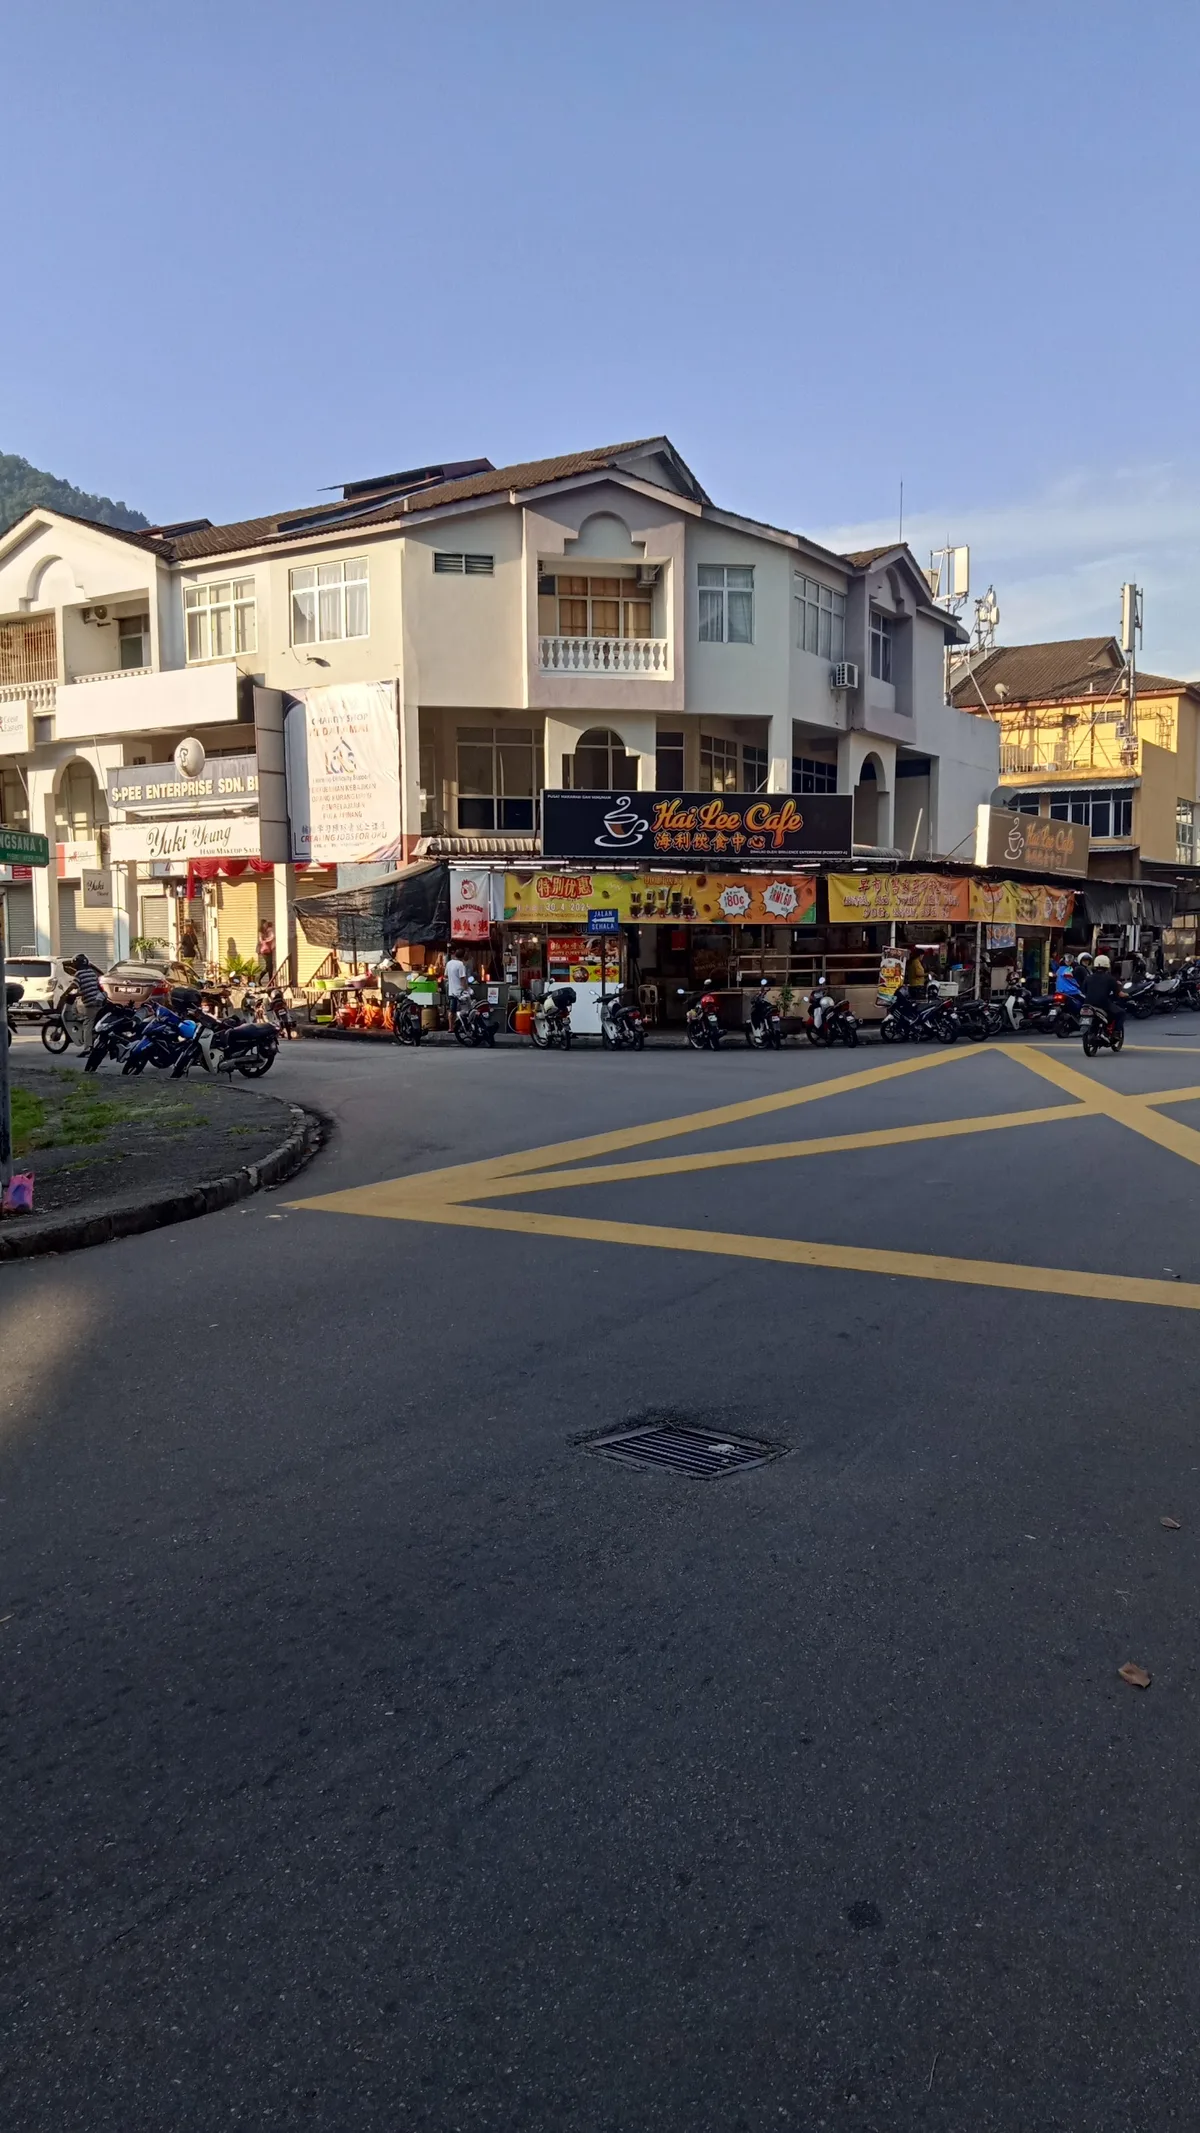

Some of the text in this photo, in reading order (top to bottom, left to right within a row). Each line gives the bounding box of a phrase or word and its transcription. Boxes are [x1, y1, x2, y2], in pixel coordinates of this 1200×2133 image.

[145, 779, 213, 800] ENTERPRISE
[217, 776, 245, 794] SDN.
[650, 797, 803, 848] Hai Lee Cafe
[38, 839, 44, 853] 1
[146, 824, 232, 857] Yuki Young
[653, 832, 765, 853] 海利饮食中心
[537, 876, 593, 899] 特别优惠
